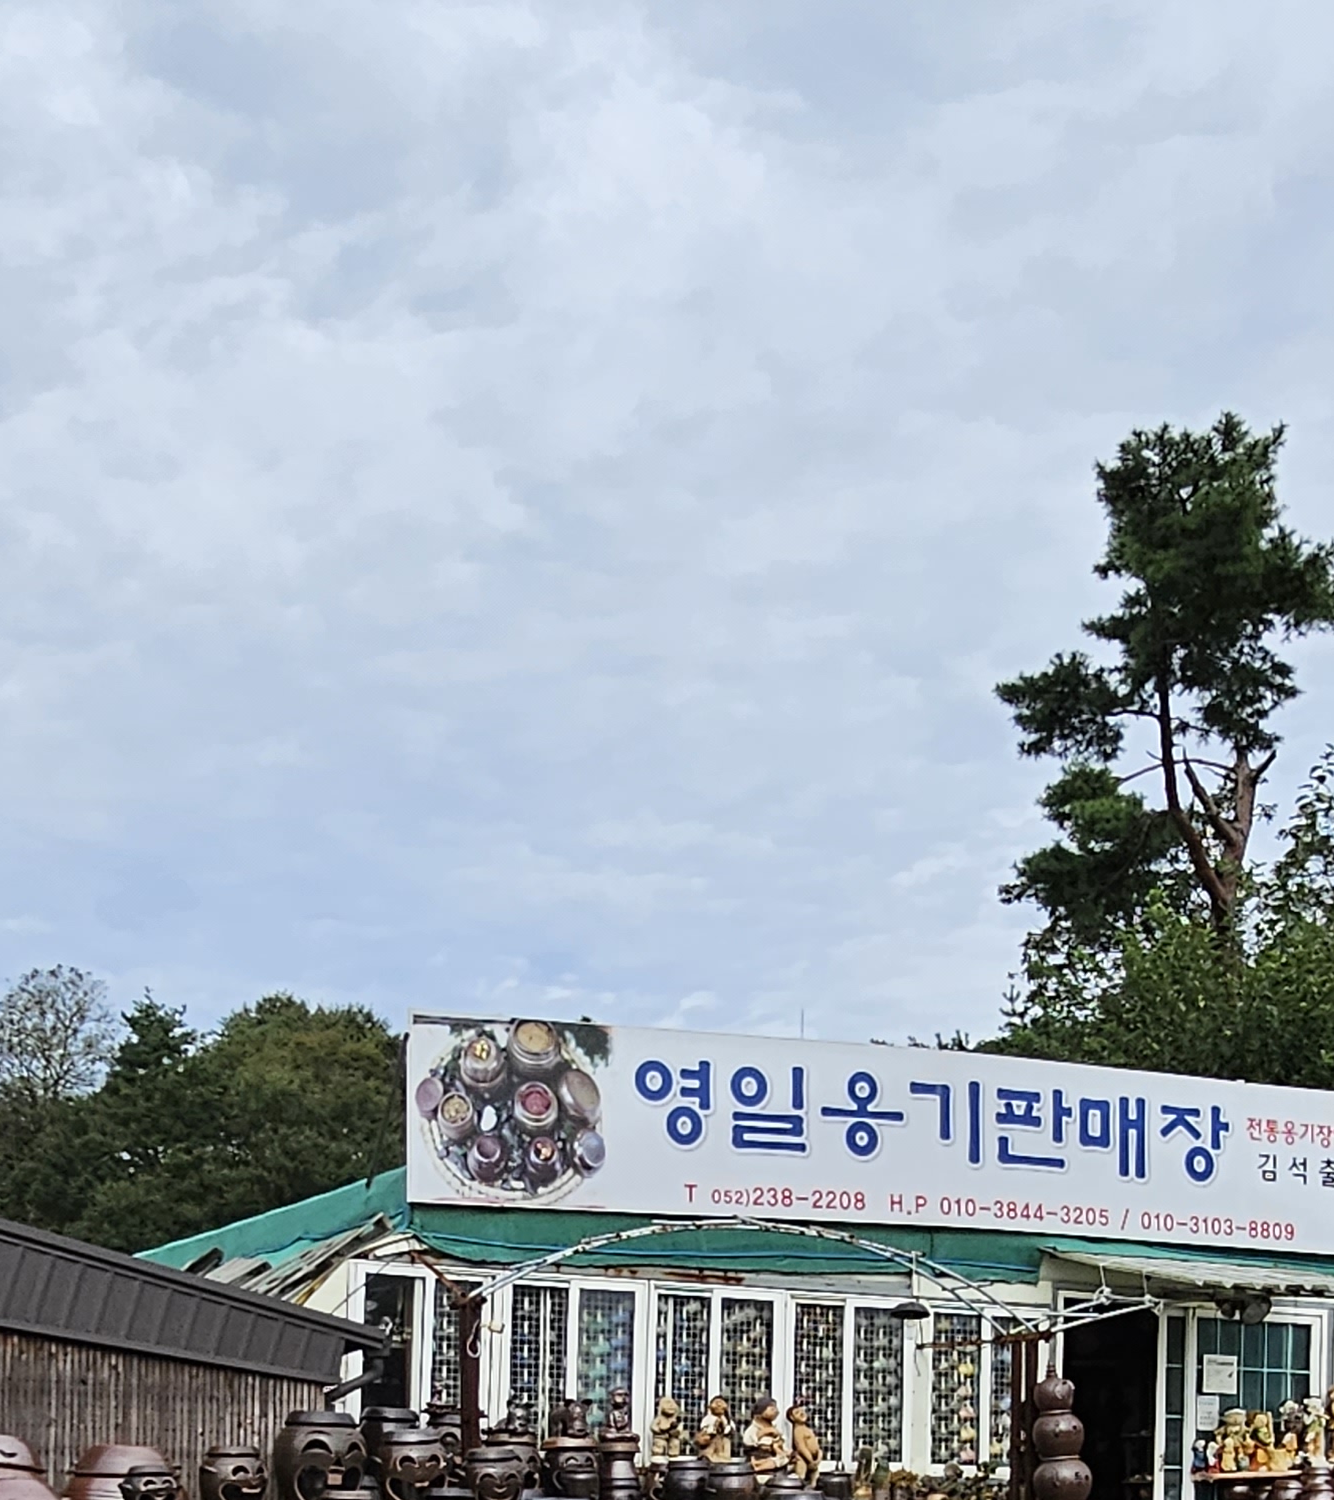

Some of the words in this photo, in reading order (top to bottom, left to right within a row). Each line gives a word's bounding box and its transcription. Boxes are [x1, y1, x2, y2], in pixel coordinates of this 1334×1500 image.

[634, 1060, 1230, 1182] 영일옹기판매장
[684, 1184, 697, 1203] T
[712, 1187, 866, 1210] 052)238-2208
[889, 1194, 928, 1215] H.P
[940, 1197, 1110, 1226] 010-3844-3205
[1141, 1212, 1295, 1241] 010-3103-8809
